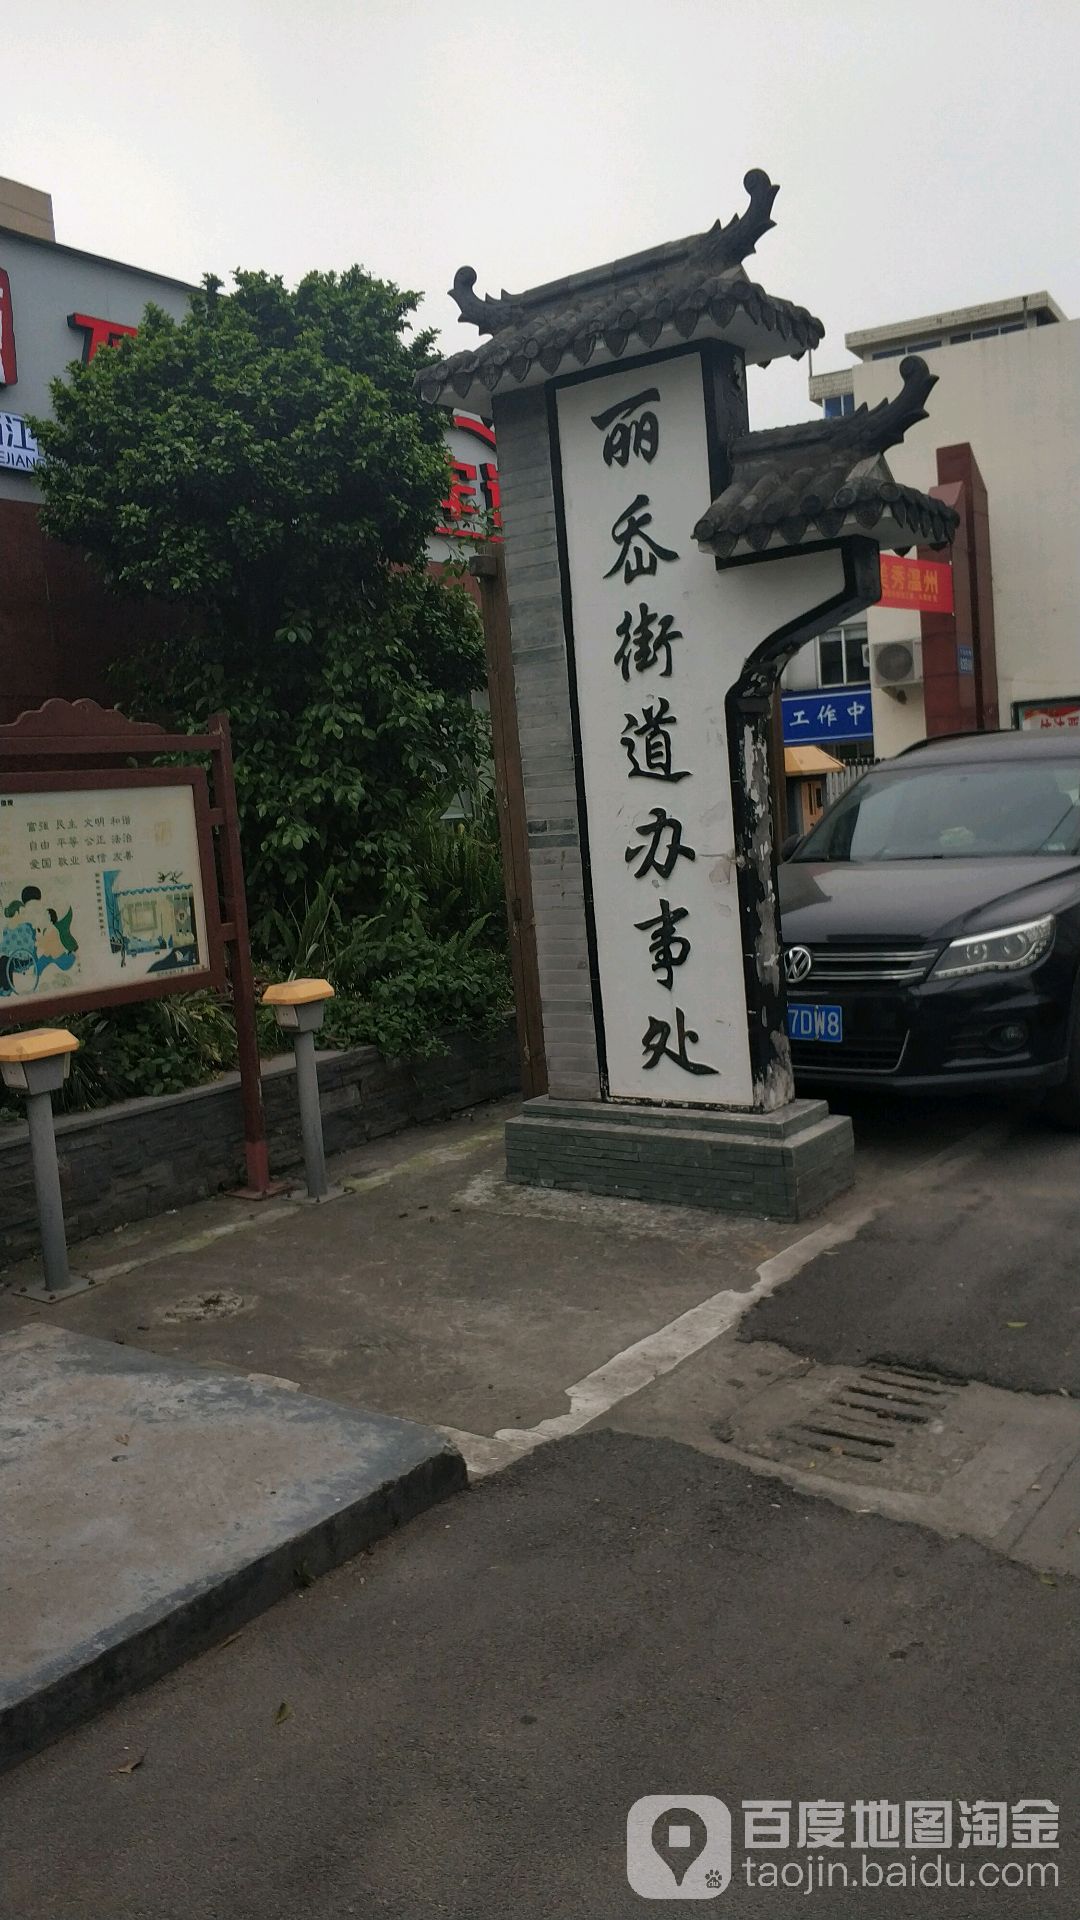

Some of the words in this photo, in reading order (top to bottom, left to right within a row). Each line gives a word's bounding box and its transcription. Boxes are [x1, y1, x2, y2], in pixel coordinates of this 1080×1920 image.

[590, 387, 720, 1076] 丽岙街道办事处
[789, 701, 865, 727] 工作中
